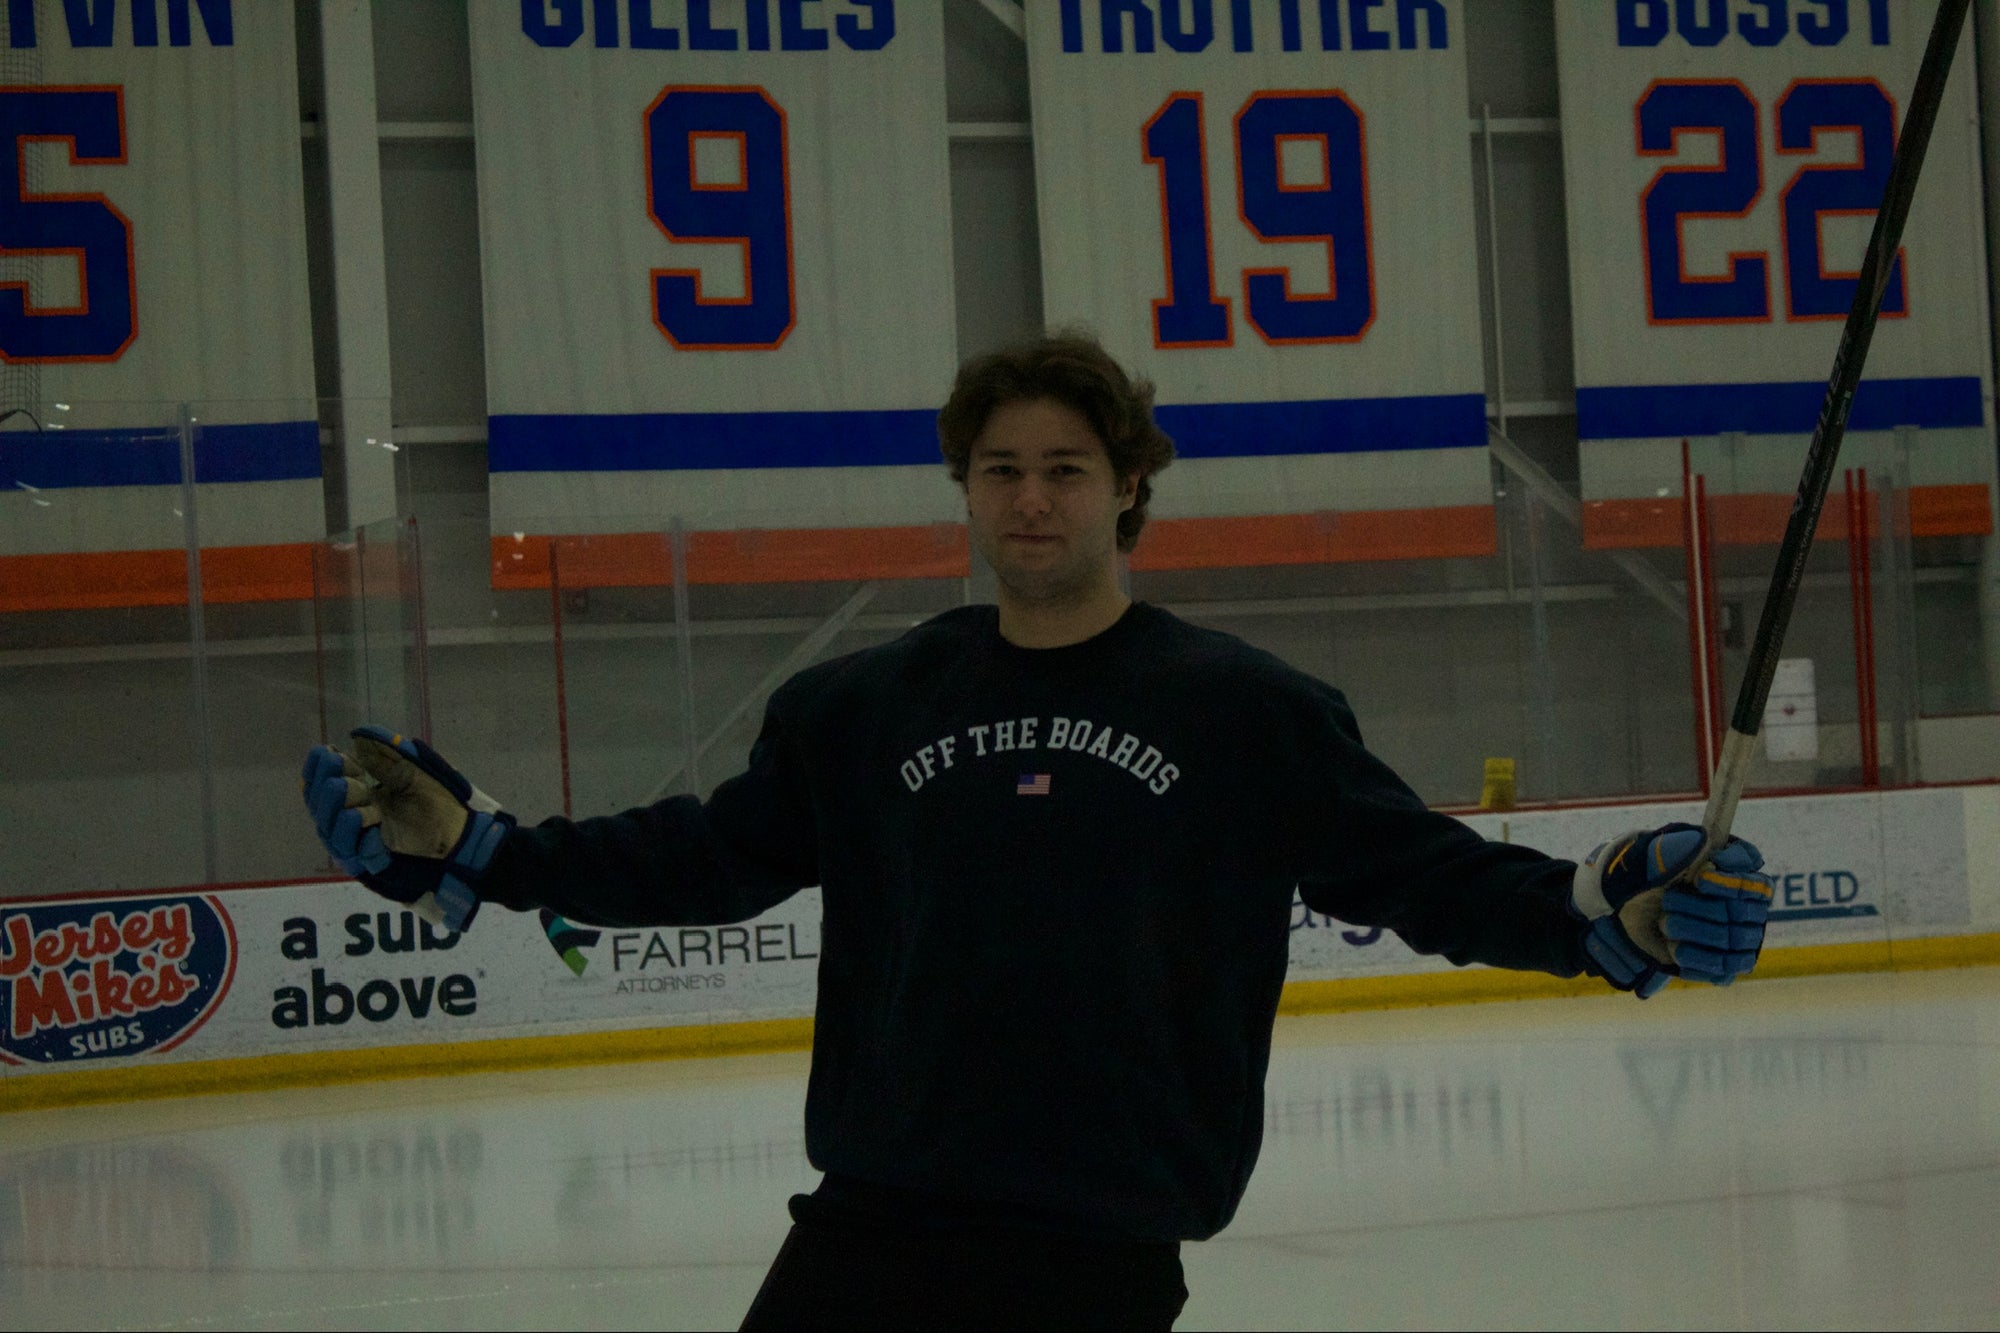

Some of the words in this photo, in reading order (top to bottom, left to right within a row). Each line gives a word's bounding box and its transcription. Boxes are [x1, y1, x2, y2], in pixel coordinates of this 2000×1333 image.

[0, 85, 138, 363] 5
[644, 85, 796, 350] 9
[1141, 89, 1377, 349] 19
[1634, 77, 1909, 326] 22
[900, 735, 957, 792] OFF
[968, 717, 1039, 756] THE
[1046, 716, 1181, 796] BOARDS
[1771, 870, 1860, 907] ELD
[0, 903, 195, 975] Jersey
[281, 917, 317, 960] a
[612, 921, 823, 972] FARREL
[271, 967, 477, 1029] above
[615, 973, 726, 995] ATTORNEYS
[70, 1020, 145, 1057] SUBS
